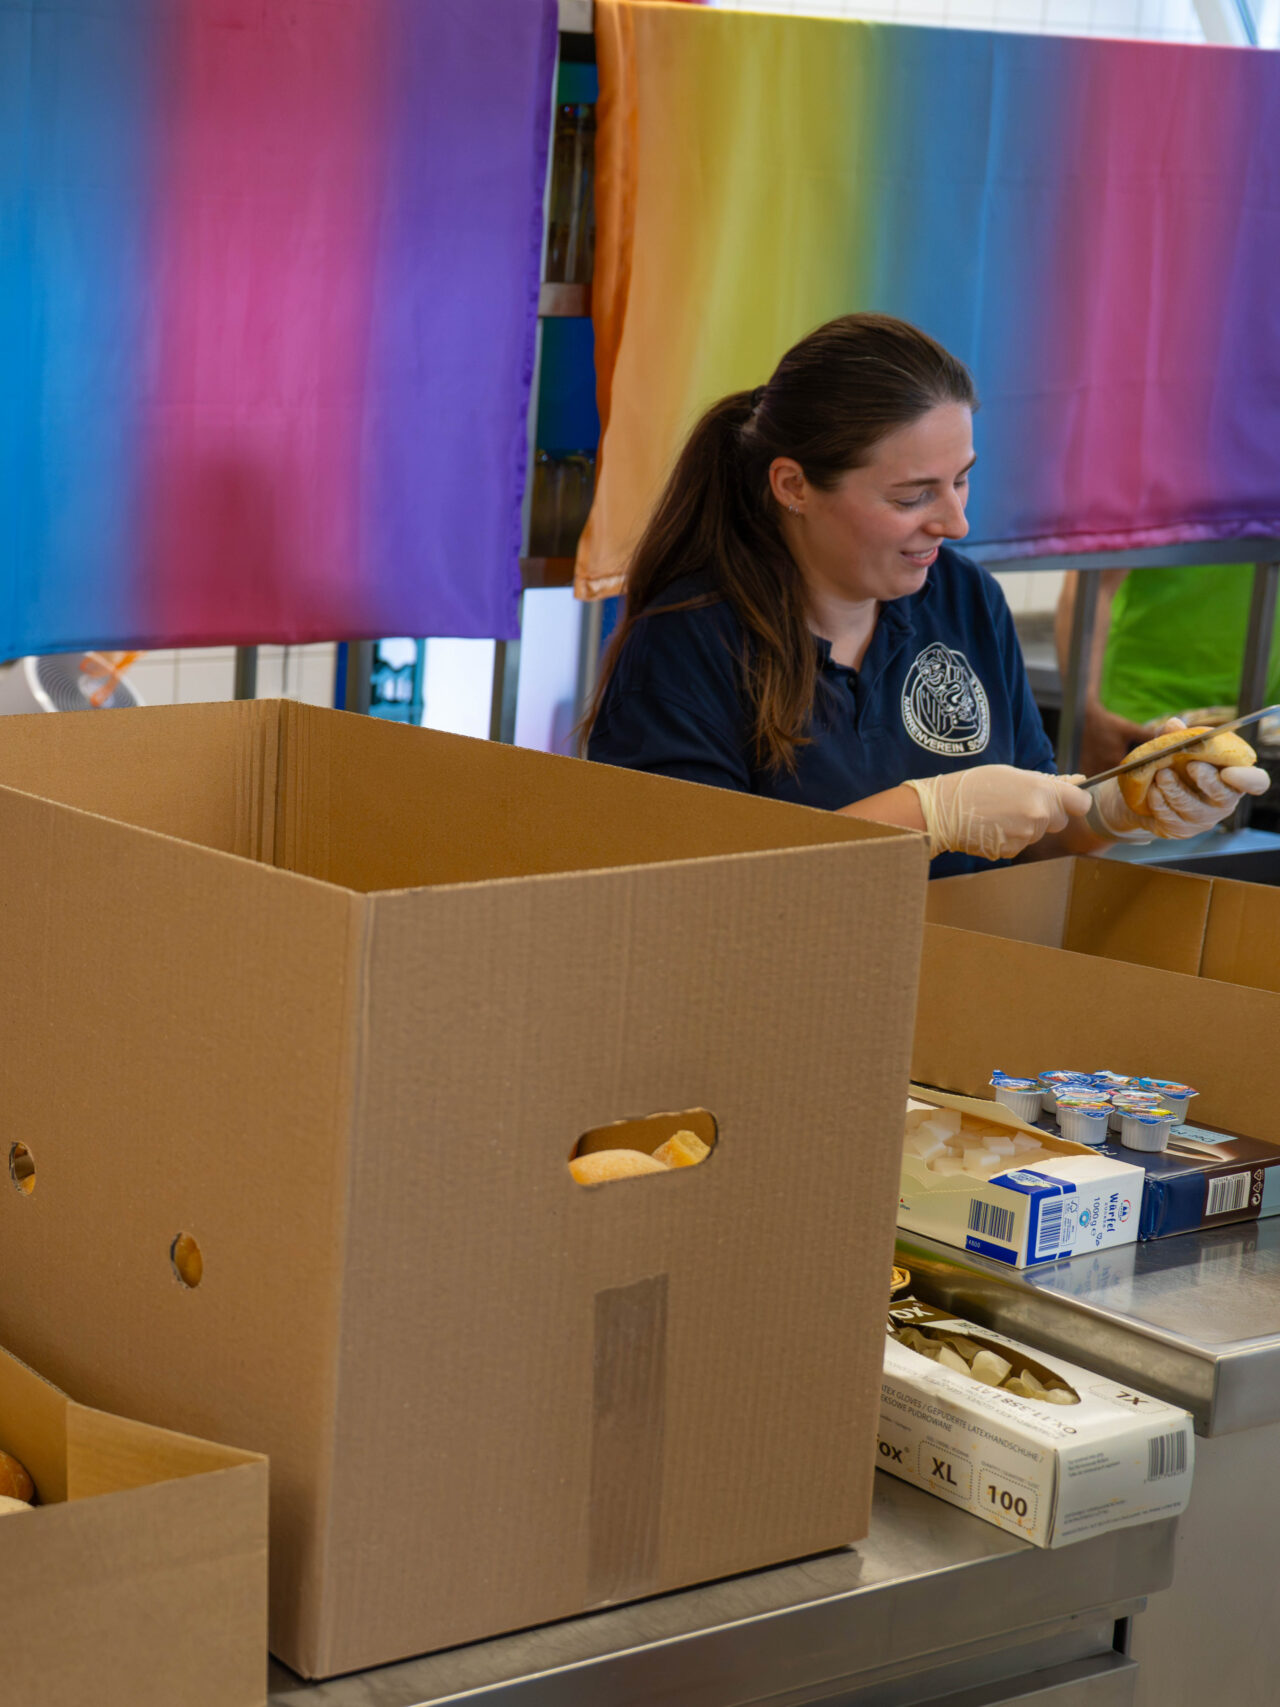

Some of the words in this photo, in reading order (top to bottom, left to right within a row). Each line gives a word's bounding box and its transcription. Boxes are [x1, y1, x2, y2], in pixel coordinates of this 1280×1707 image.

[904, 695, 965, 753] NARRENVEREIN
[1106, 1192, 1119, 1233] Würfel
[1116, 1391, 1149, 1406] XL
[896, 1389, 922, 1409] GLOVES
[927, 1404, 967, 1429] GEPUDERTE
[967, 1424, 1039, 1463] LATEXHANDSCHUHE
[907, 1407, 953, 1433] PUDROWANE
[931, 1456, 958, 1487] XL
[987, 1484, 1028, 1518] 100
